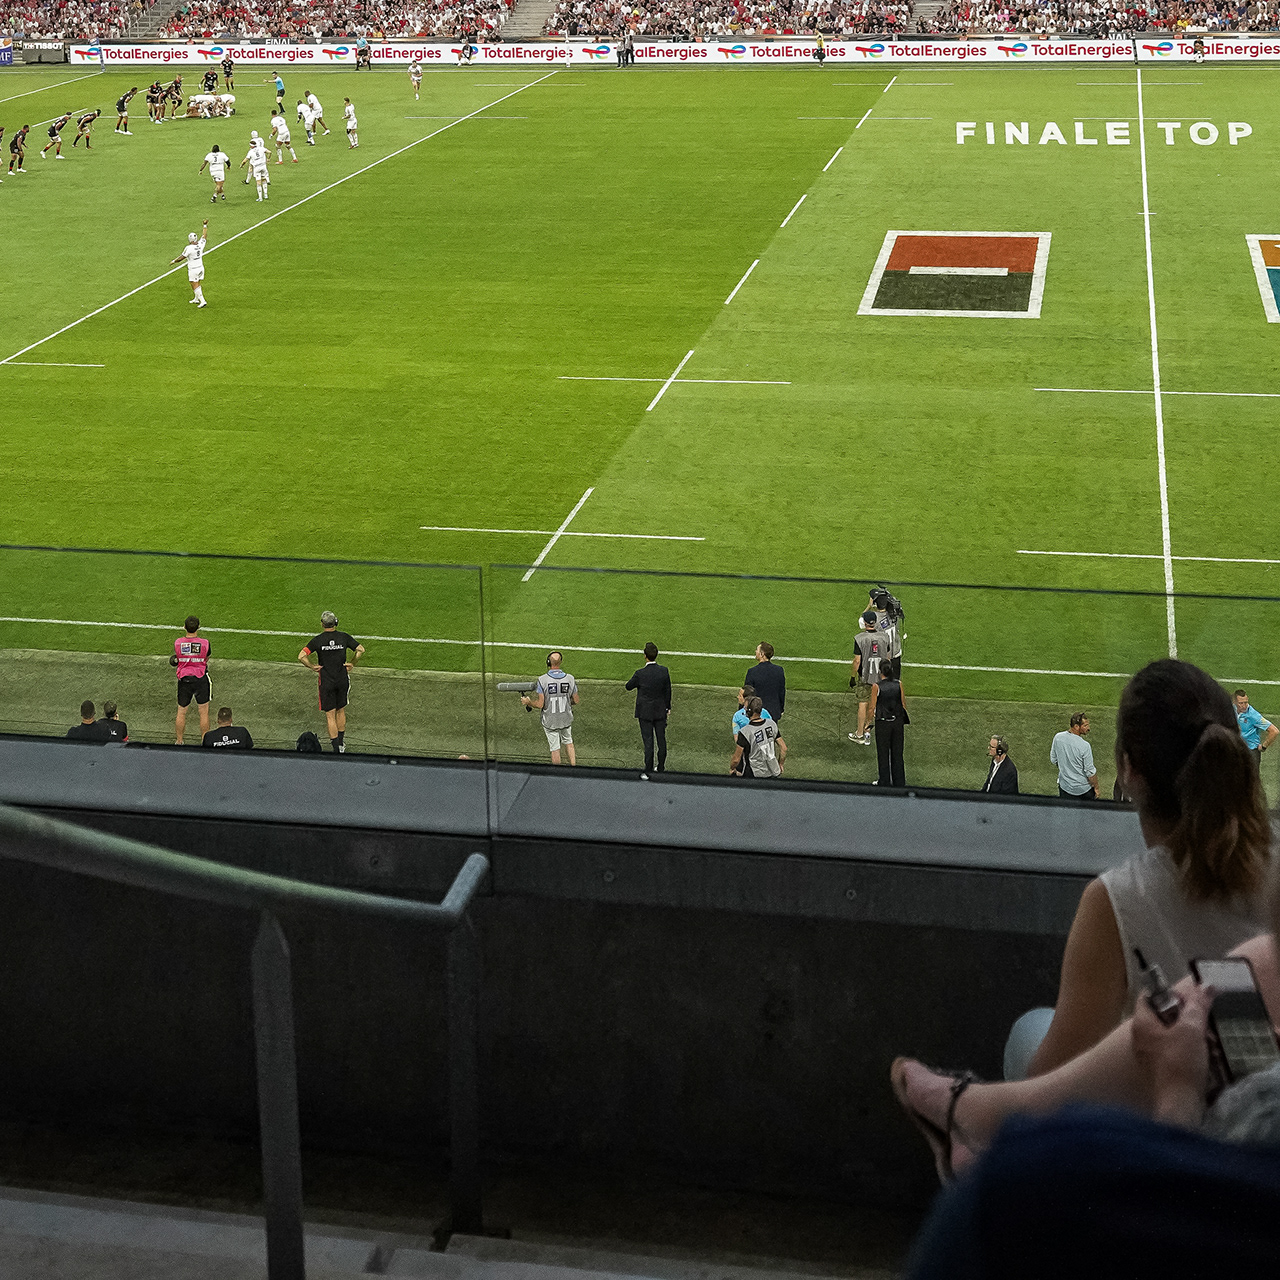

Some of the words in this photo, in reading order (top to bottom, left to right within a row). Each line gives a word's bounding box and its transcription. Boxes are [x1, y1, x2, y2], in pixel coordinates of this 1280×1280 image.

[103, 47, 188, 62] TotalEnergies
[226, 46, 313, 62] TotalEnergies
[750, 45, 845, 60] TotalEneries
[888, 45, 986, 60] TotalEnergies
[1031, 44, 1132, 59] TotalEnergies
[1177, 43, 1280, 58] ToalEnergies
[955, 121, 1130, 145] FINALE
[1157, 121, 1253, 146] TOP
